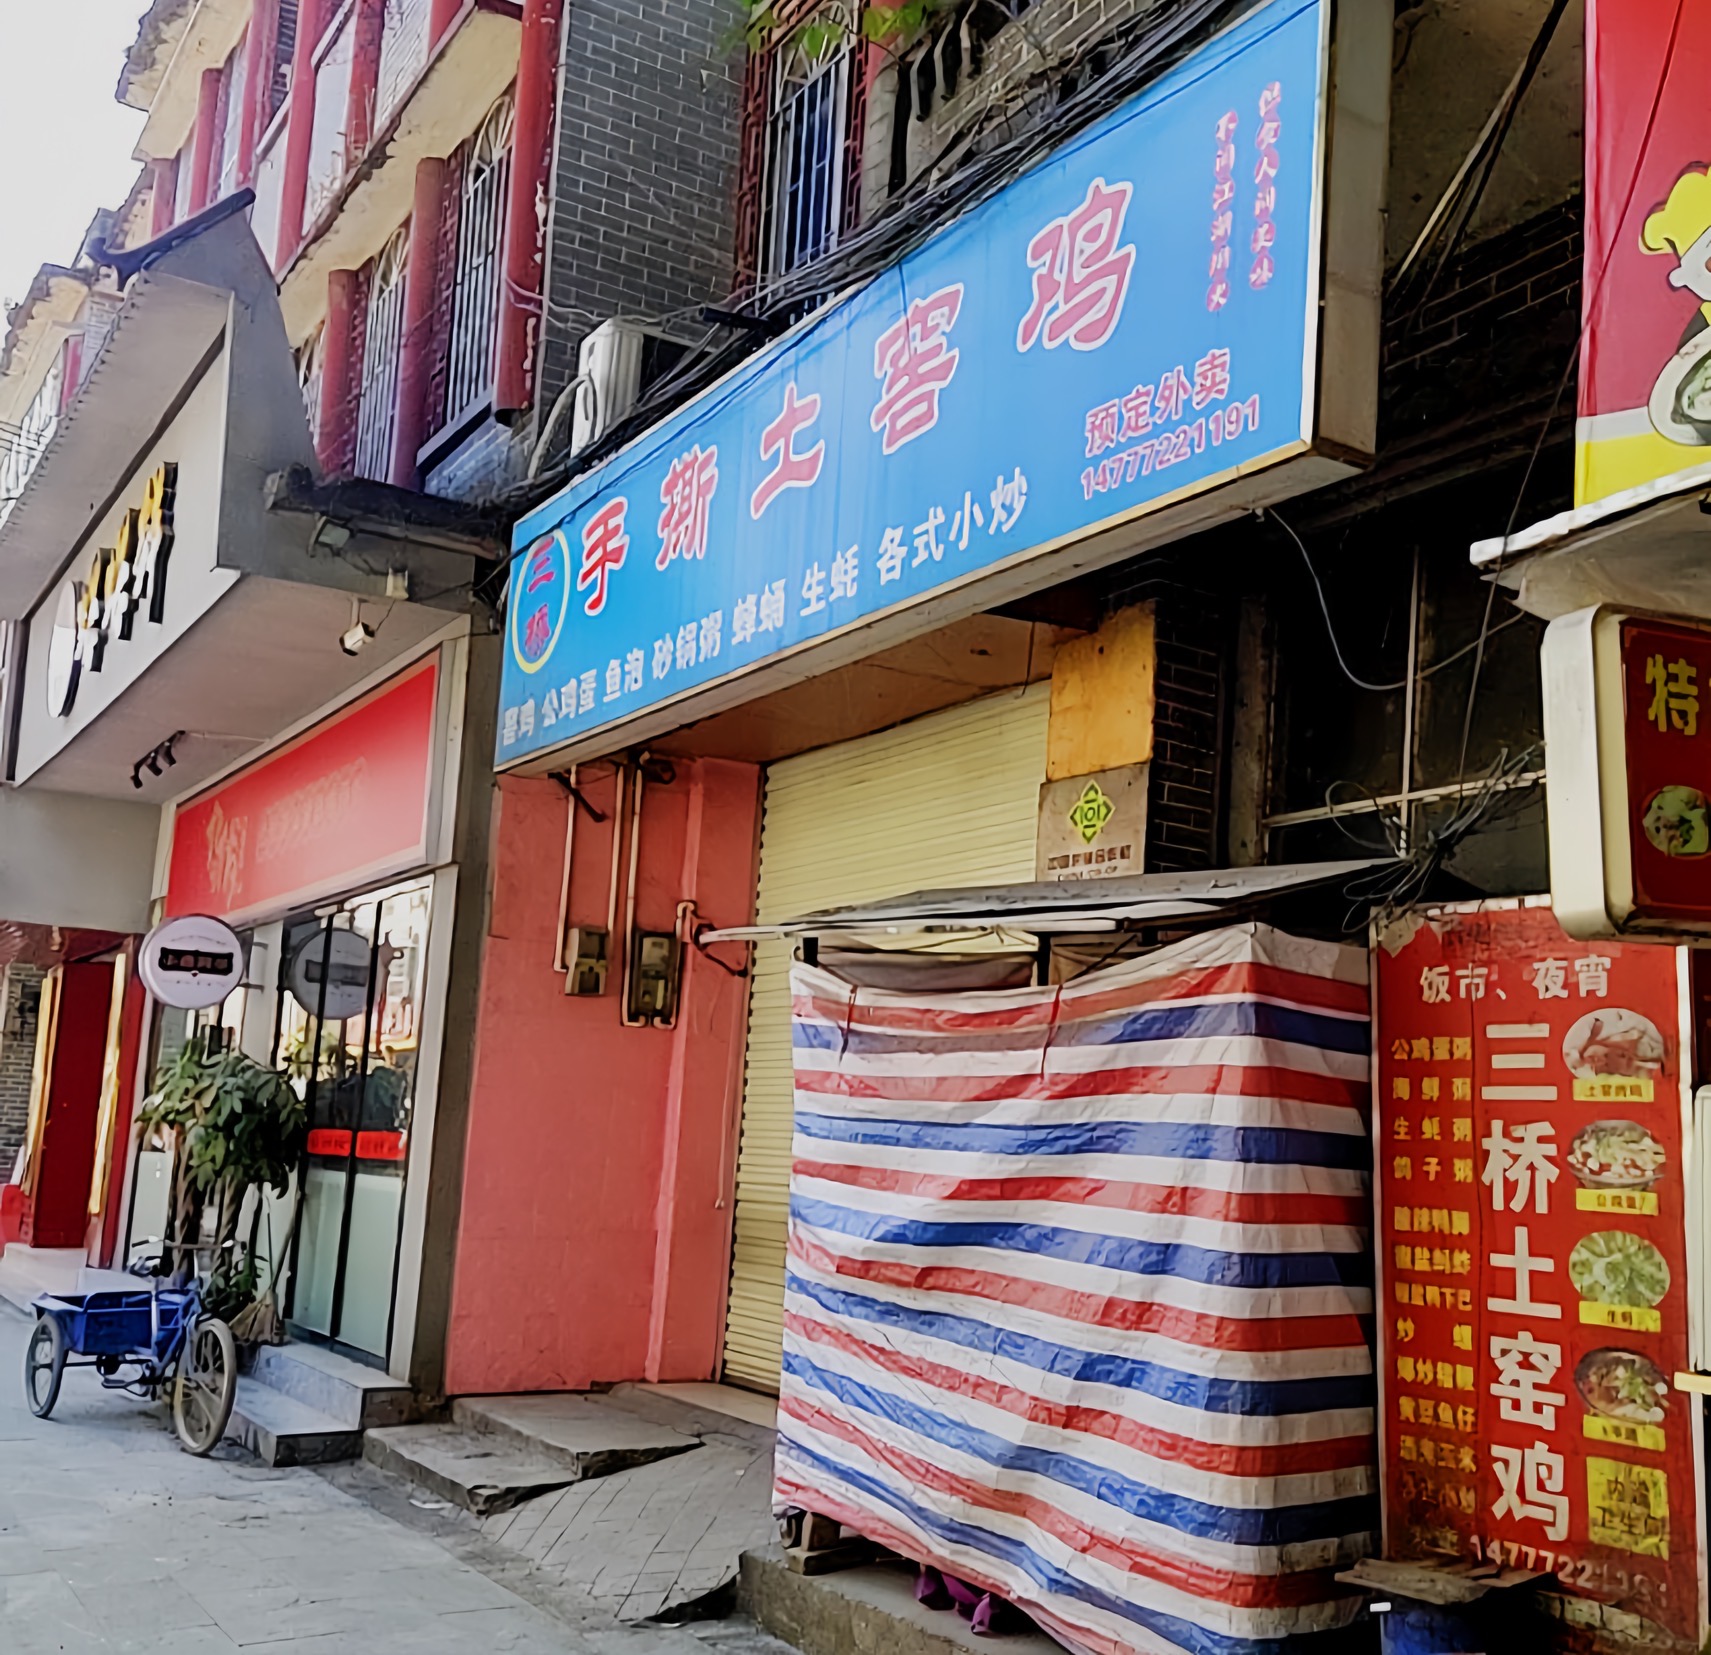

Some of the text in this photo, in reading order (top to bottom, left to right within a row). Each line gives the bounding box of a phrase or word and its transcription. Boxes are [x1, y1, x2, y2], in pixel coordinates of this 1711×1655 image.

[1080, 394, 1261, 500] 14777221191
[1085, 347, 1230, 459] 预定外卖
[652, 611, 722, 680] 砂锅粥
[800, 544, 859, 617] 生蚝
[876, 466, 1028, 586] 各式小炒
[1481, 1022, 1570, 1542] 三桥土窑鸡
